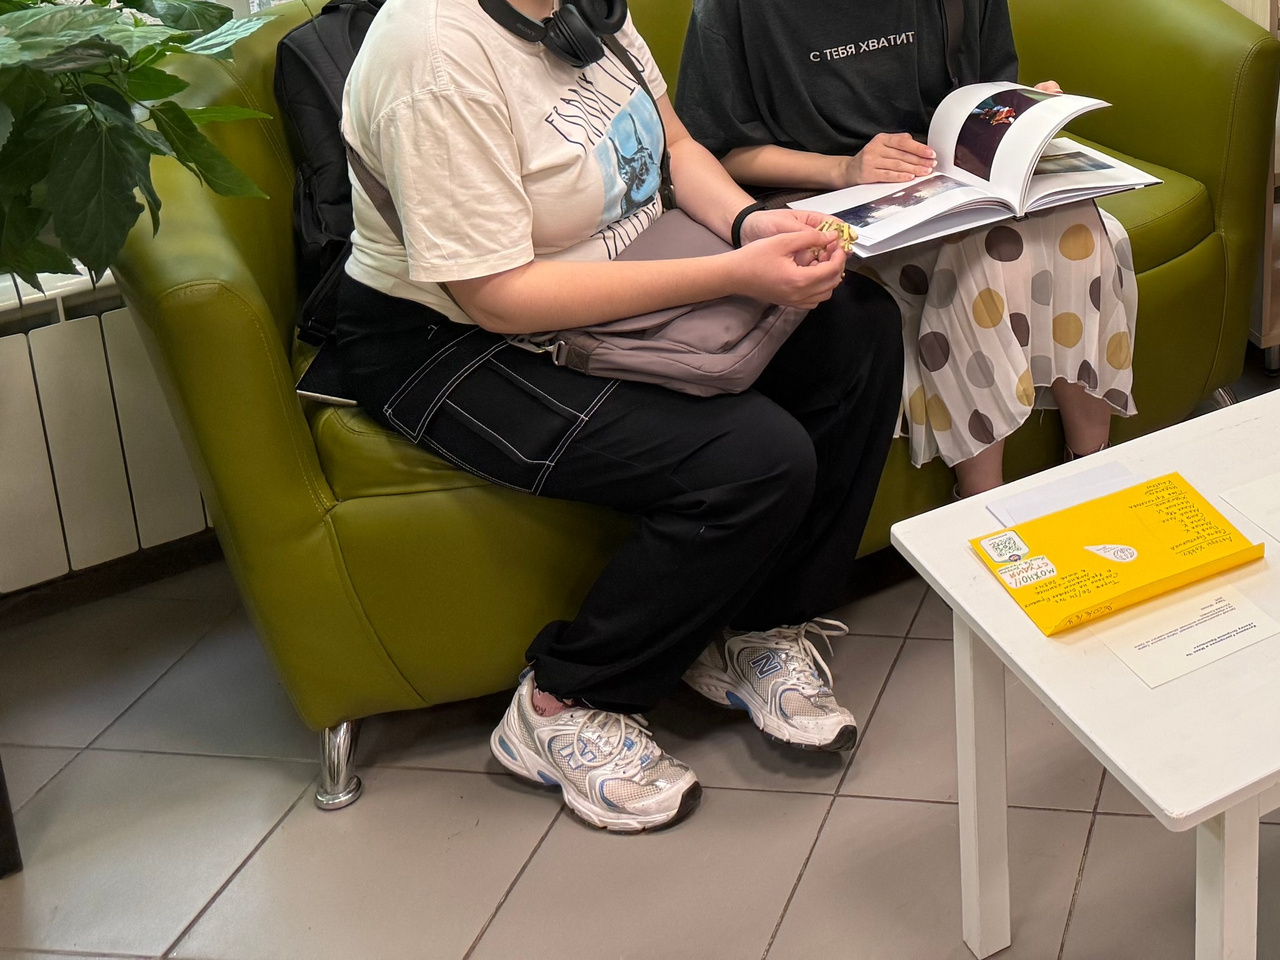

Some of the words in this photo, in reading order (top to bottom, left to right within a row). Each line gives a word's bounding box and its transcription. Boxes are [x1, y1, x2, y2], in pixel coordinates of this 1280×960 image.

[809, 51, 821, 62] С
[823, 43, 856, 61] ТЕБЯ
[858, 31, 915, 53] ХВАТИТ
[1008, 560, 1049, 580] СТУДИЯ
[748, 650, 783, 680] N
